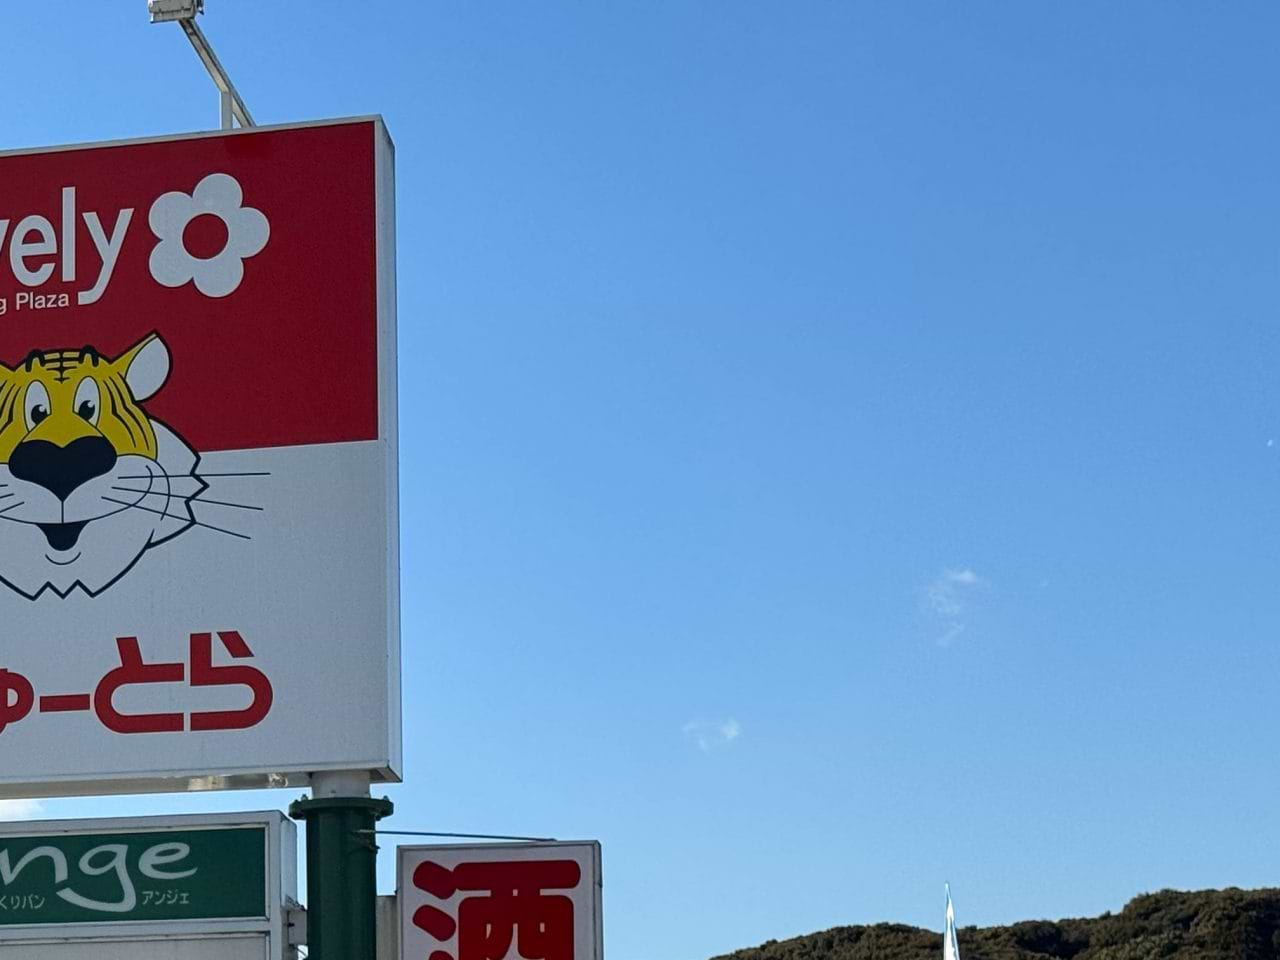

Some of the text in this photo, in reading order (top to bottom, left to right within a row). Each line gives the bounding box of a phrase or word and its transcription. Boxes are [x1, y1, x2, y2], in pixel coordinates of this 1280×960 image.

[15, 292, 70, 311] Plaza
[141, 889, 190, 906] アンジェ
